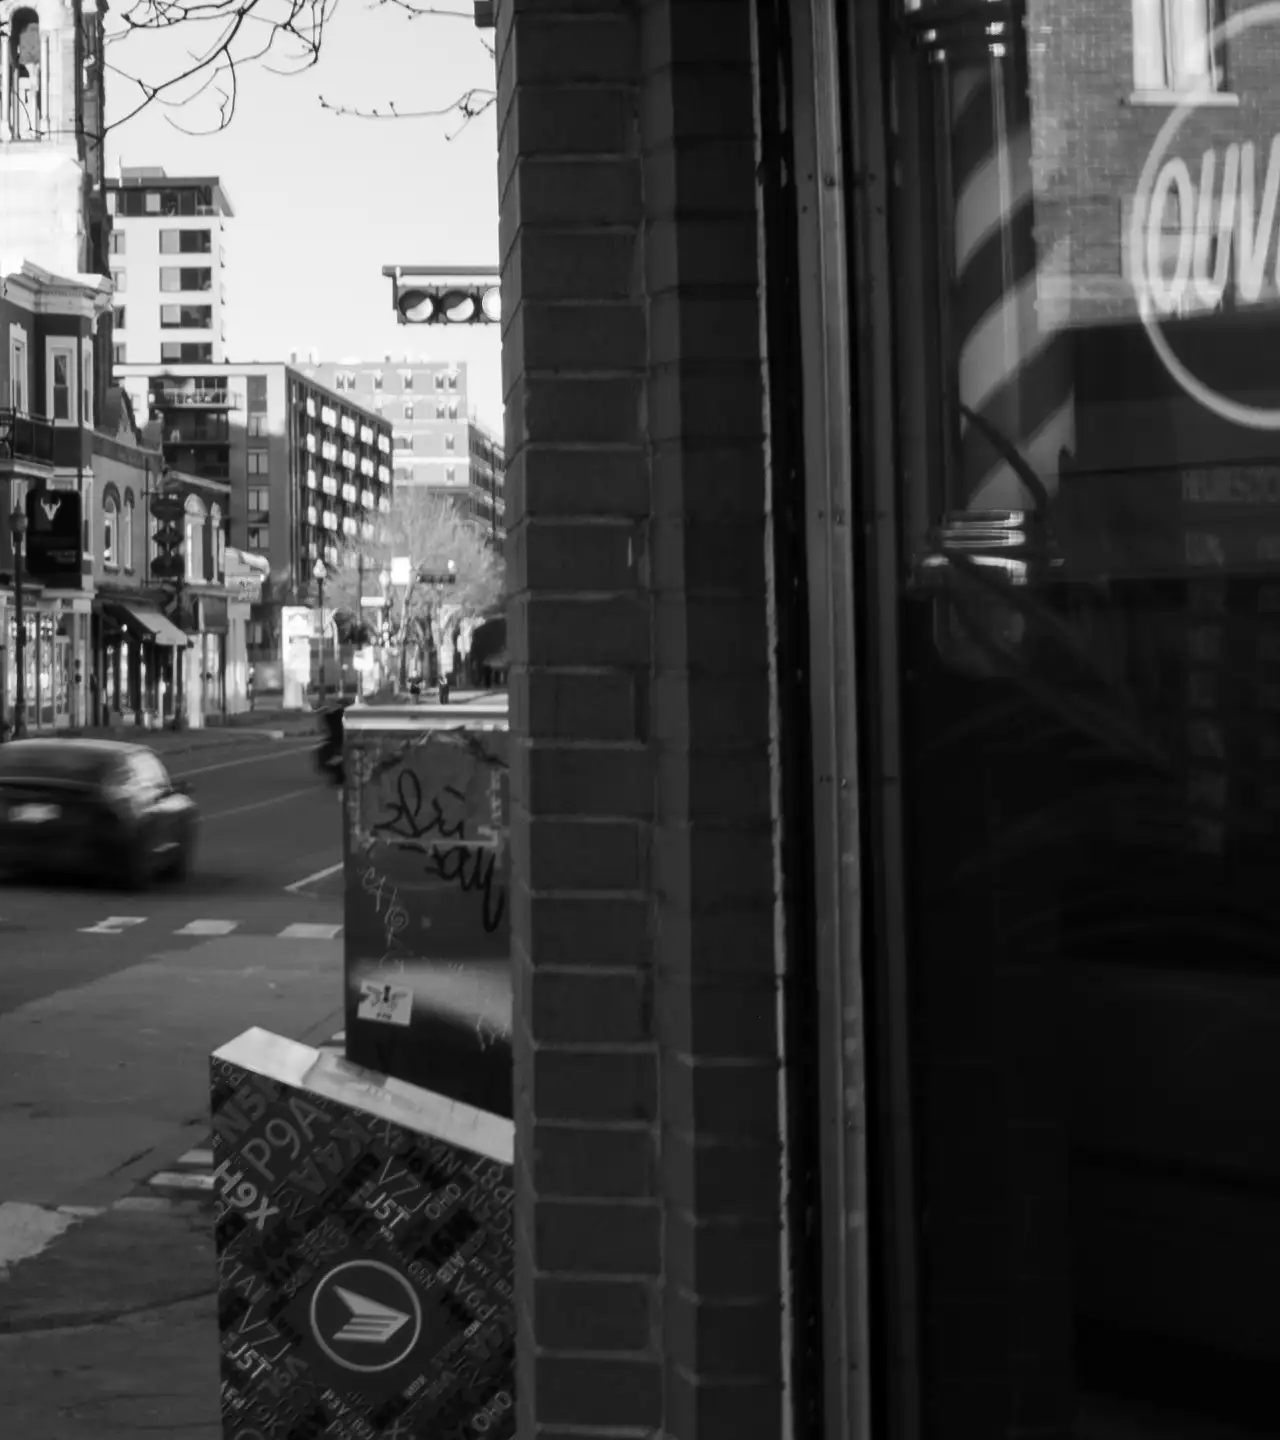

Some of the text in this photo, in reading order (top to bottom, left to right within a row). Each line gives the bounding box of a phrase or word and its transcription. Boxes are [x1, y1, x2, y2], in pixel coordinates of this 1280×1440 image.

[1147, 131, 1280, 312] OUV
[240, 1096, 331, 1182] P9A
[213, 1159, 280, 1230] H9X
[365, 1192, 411, 1228] J5T
[377, 1156, 433, 1213] V7J
[227, 1342, 273, 1378] J5T
